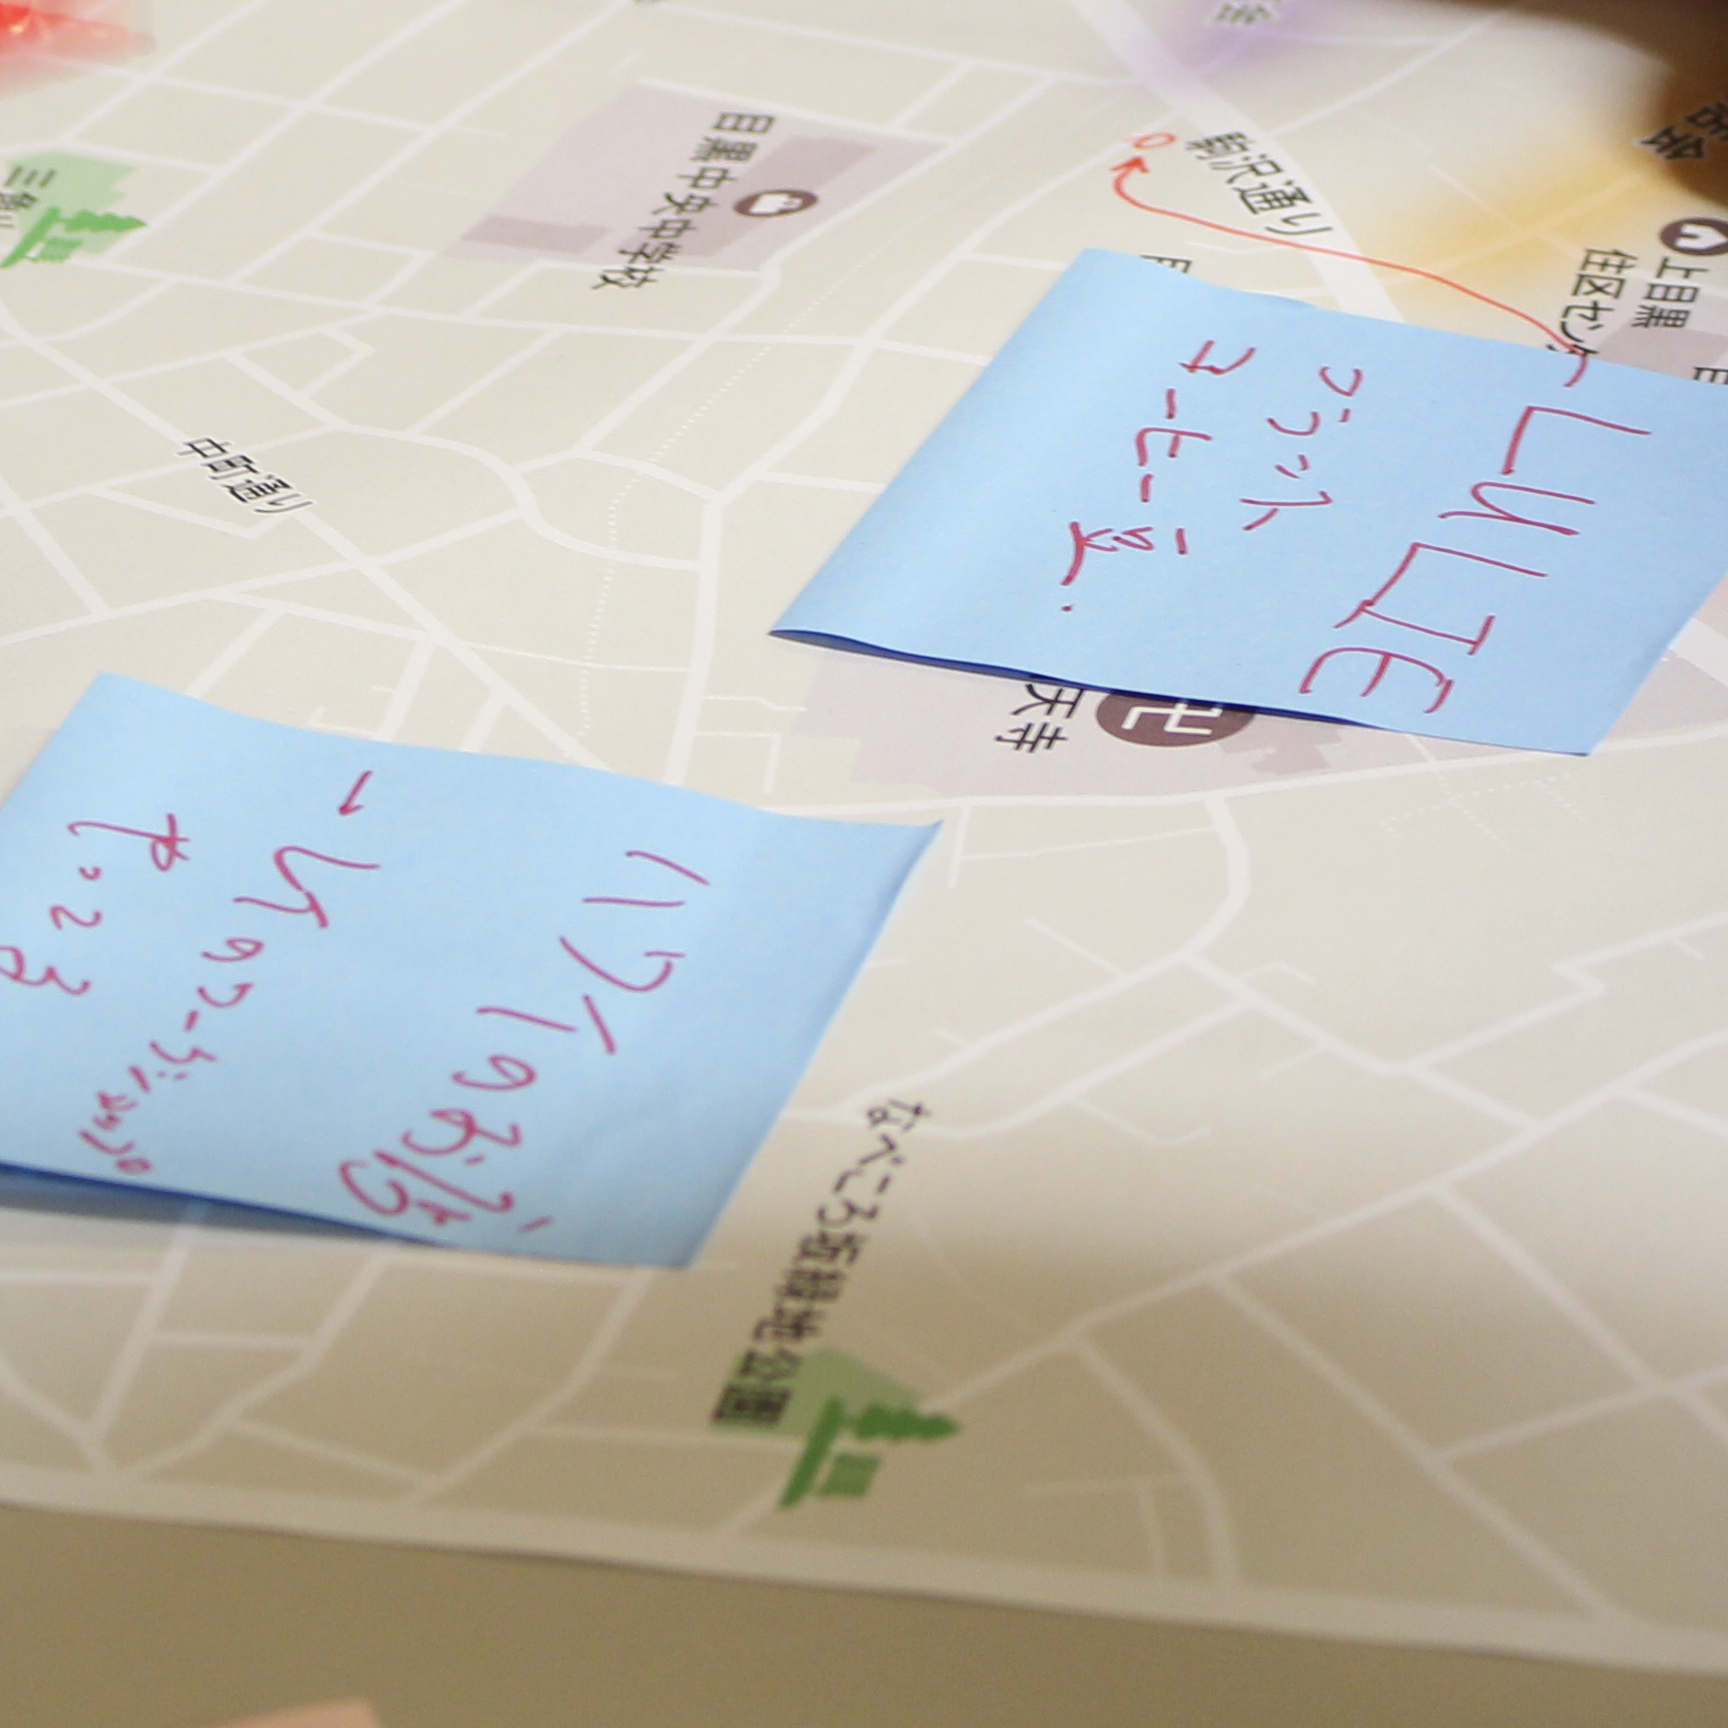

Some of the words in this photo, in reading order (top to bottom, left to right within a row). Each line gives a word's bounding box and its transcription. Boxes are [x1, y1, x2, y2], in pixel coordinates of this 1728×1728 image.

[590, 109, 776, 294] 目黒中央中学校
[1183, 129, 1336, 241] 駒沢通り
[1632, 257, 1708, 328] 上目黒
[177, 434, 314, 517] 中町通り
[1298, 404, 1652, 714] LULIE
[711, 1095, 935, 1429] なべころ坂緑地公園
